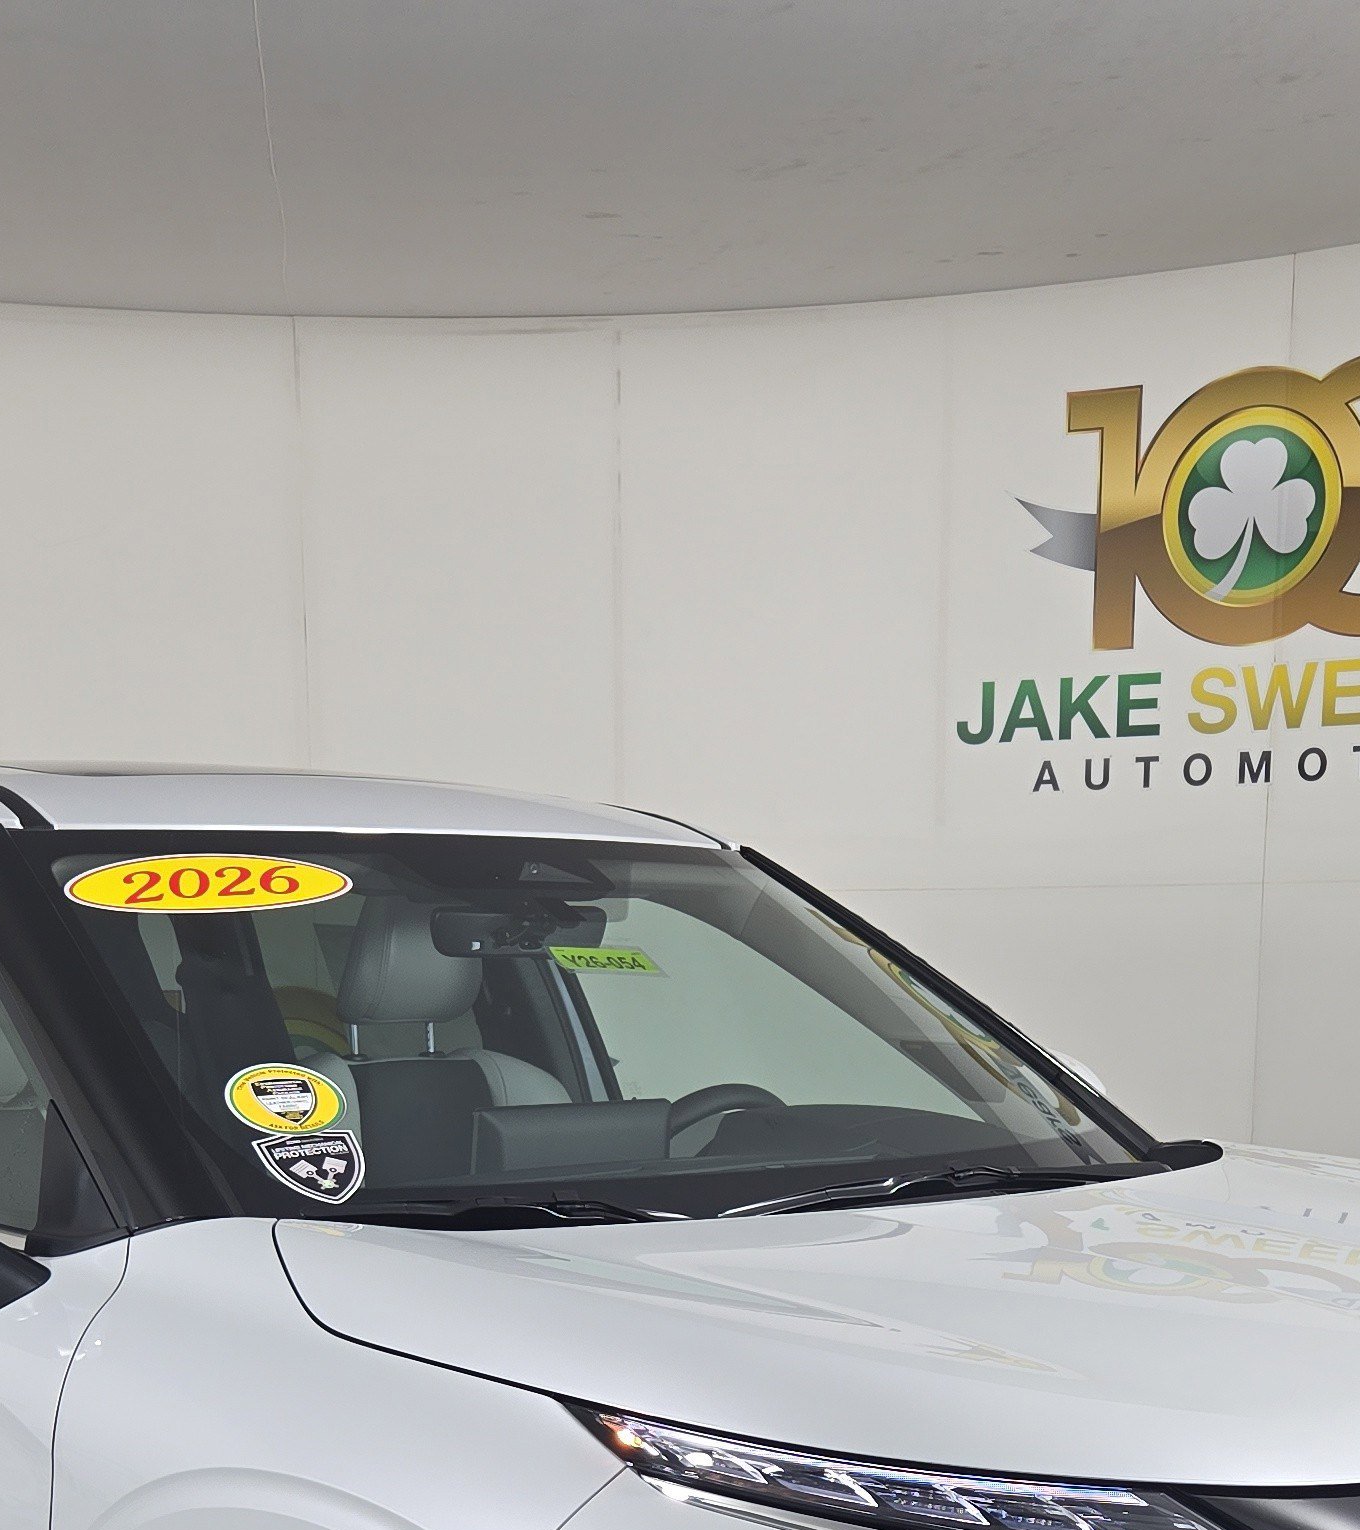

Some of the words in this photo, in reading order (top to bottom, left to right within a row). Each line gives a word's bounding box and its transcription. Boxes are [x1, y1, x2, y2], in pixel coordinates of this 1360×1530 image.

[956, 672, 1162, 745] JAKE
[122, 864, 300, 905] 2026
[561, 954, 648, 971] Y26-054
[273, 1144, 350, 1161] PROTECTION
